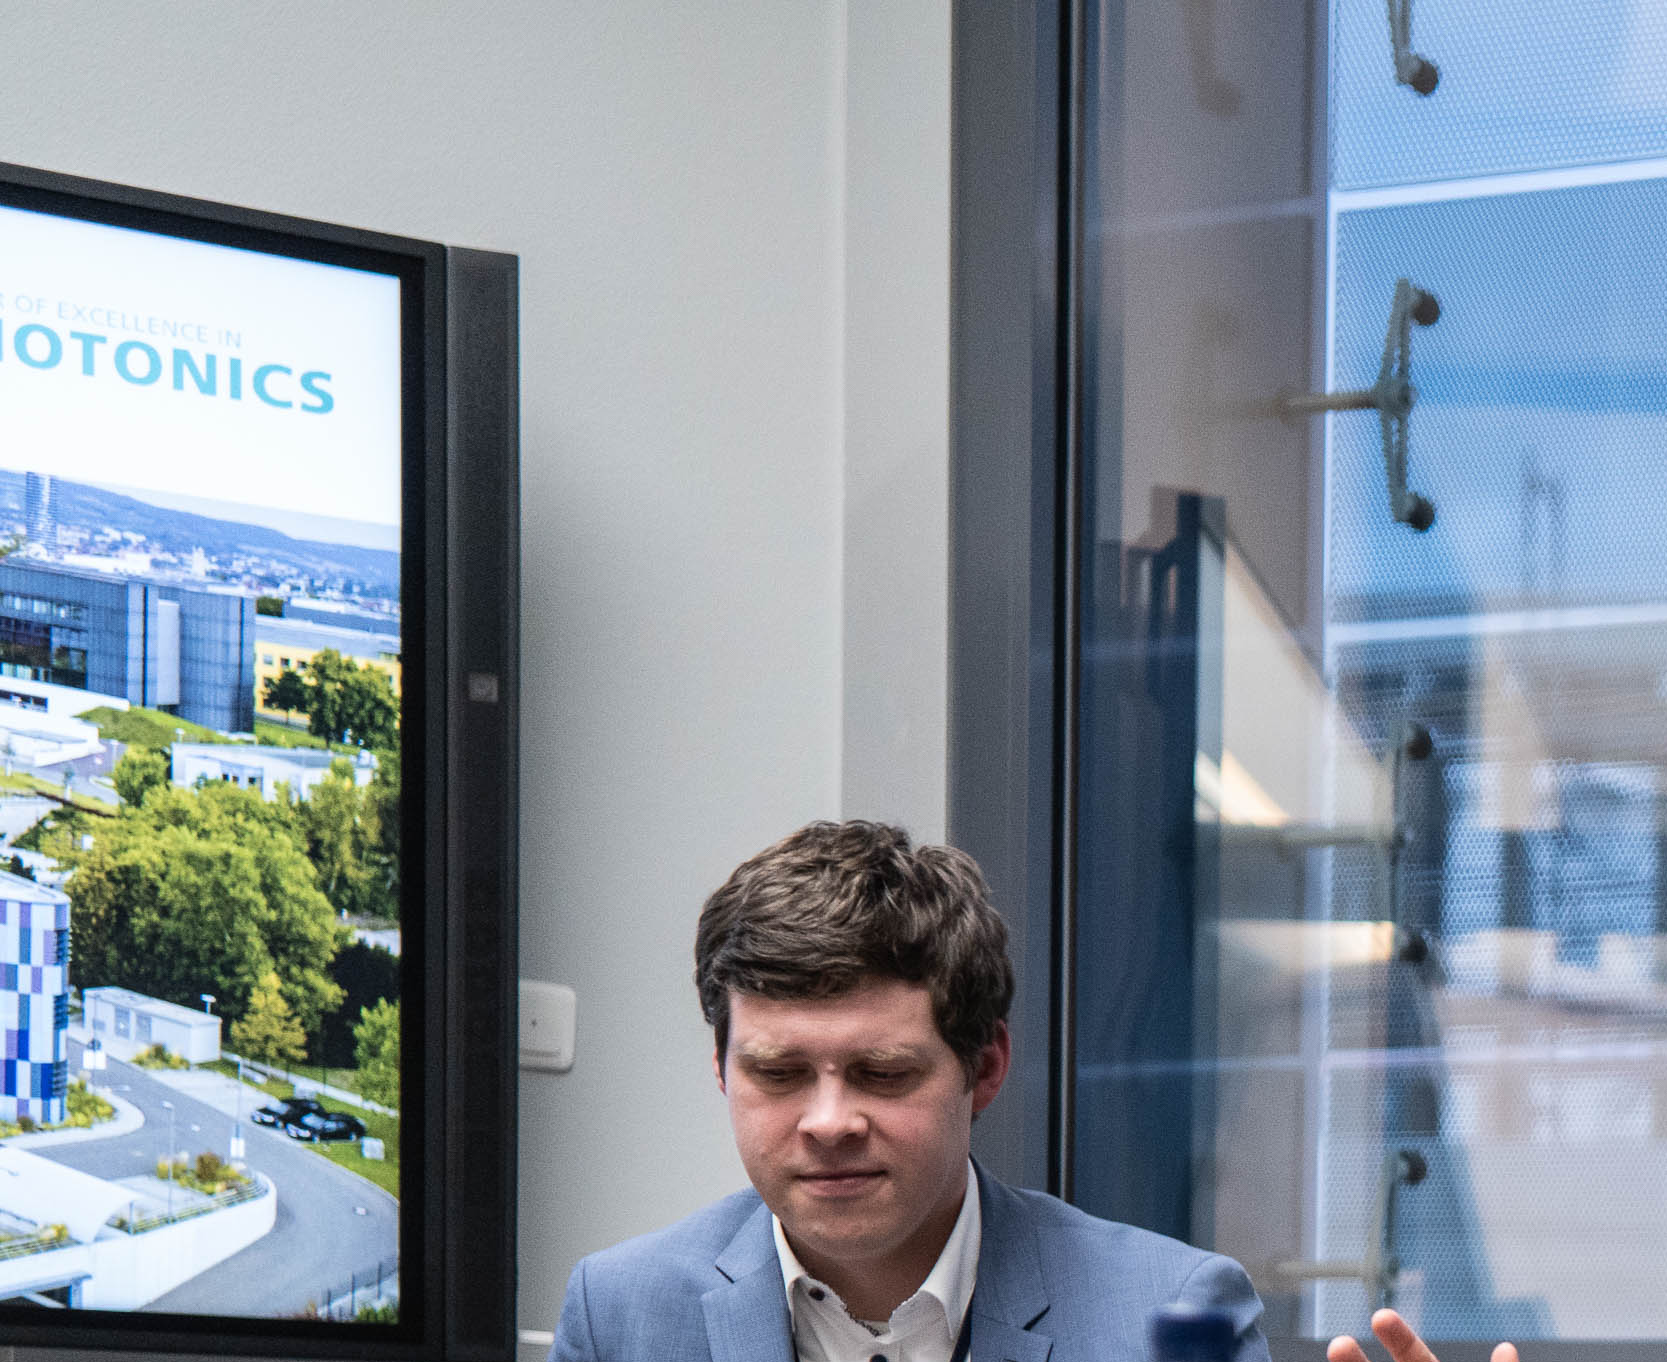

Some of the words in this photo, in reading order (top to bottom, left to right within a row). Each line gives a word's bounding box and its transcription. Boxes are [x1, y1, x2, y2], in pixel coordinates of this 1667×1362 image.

[15, 294, 47, 315] OF
[58, 301, 208, 344] EXCELLENCE
[217, 329, 241, 349] IN
[0, 318, 334, 414] OTONICS
